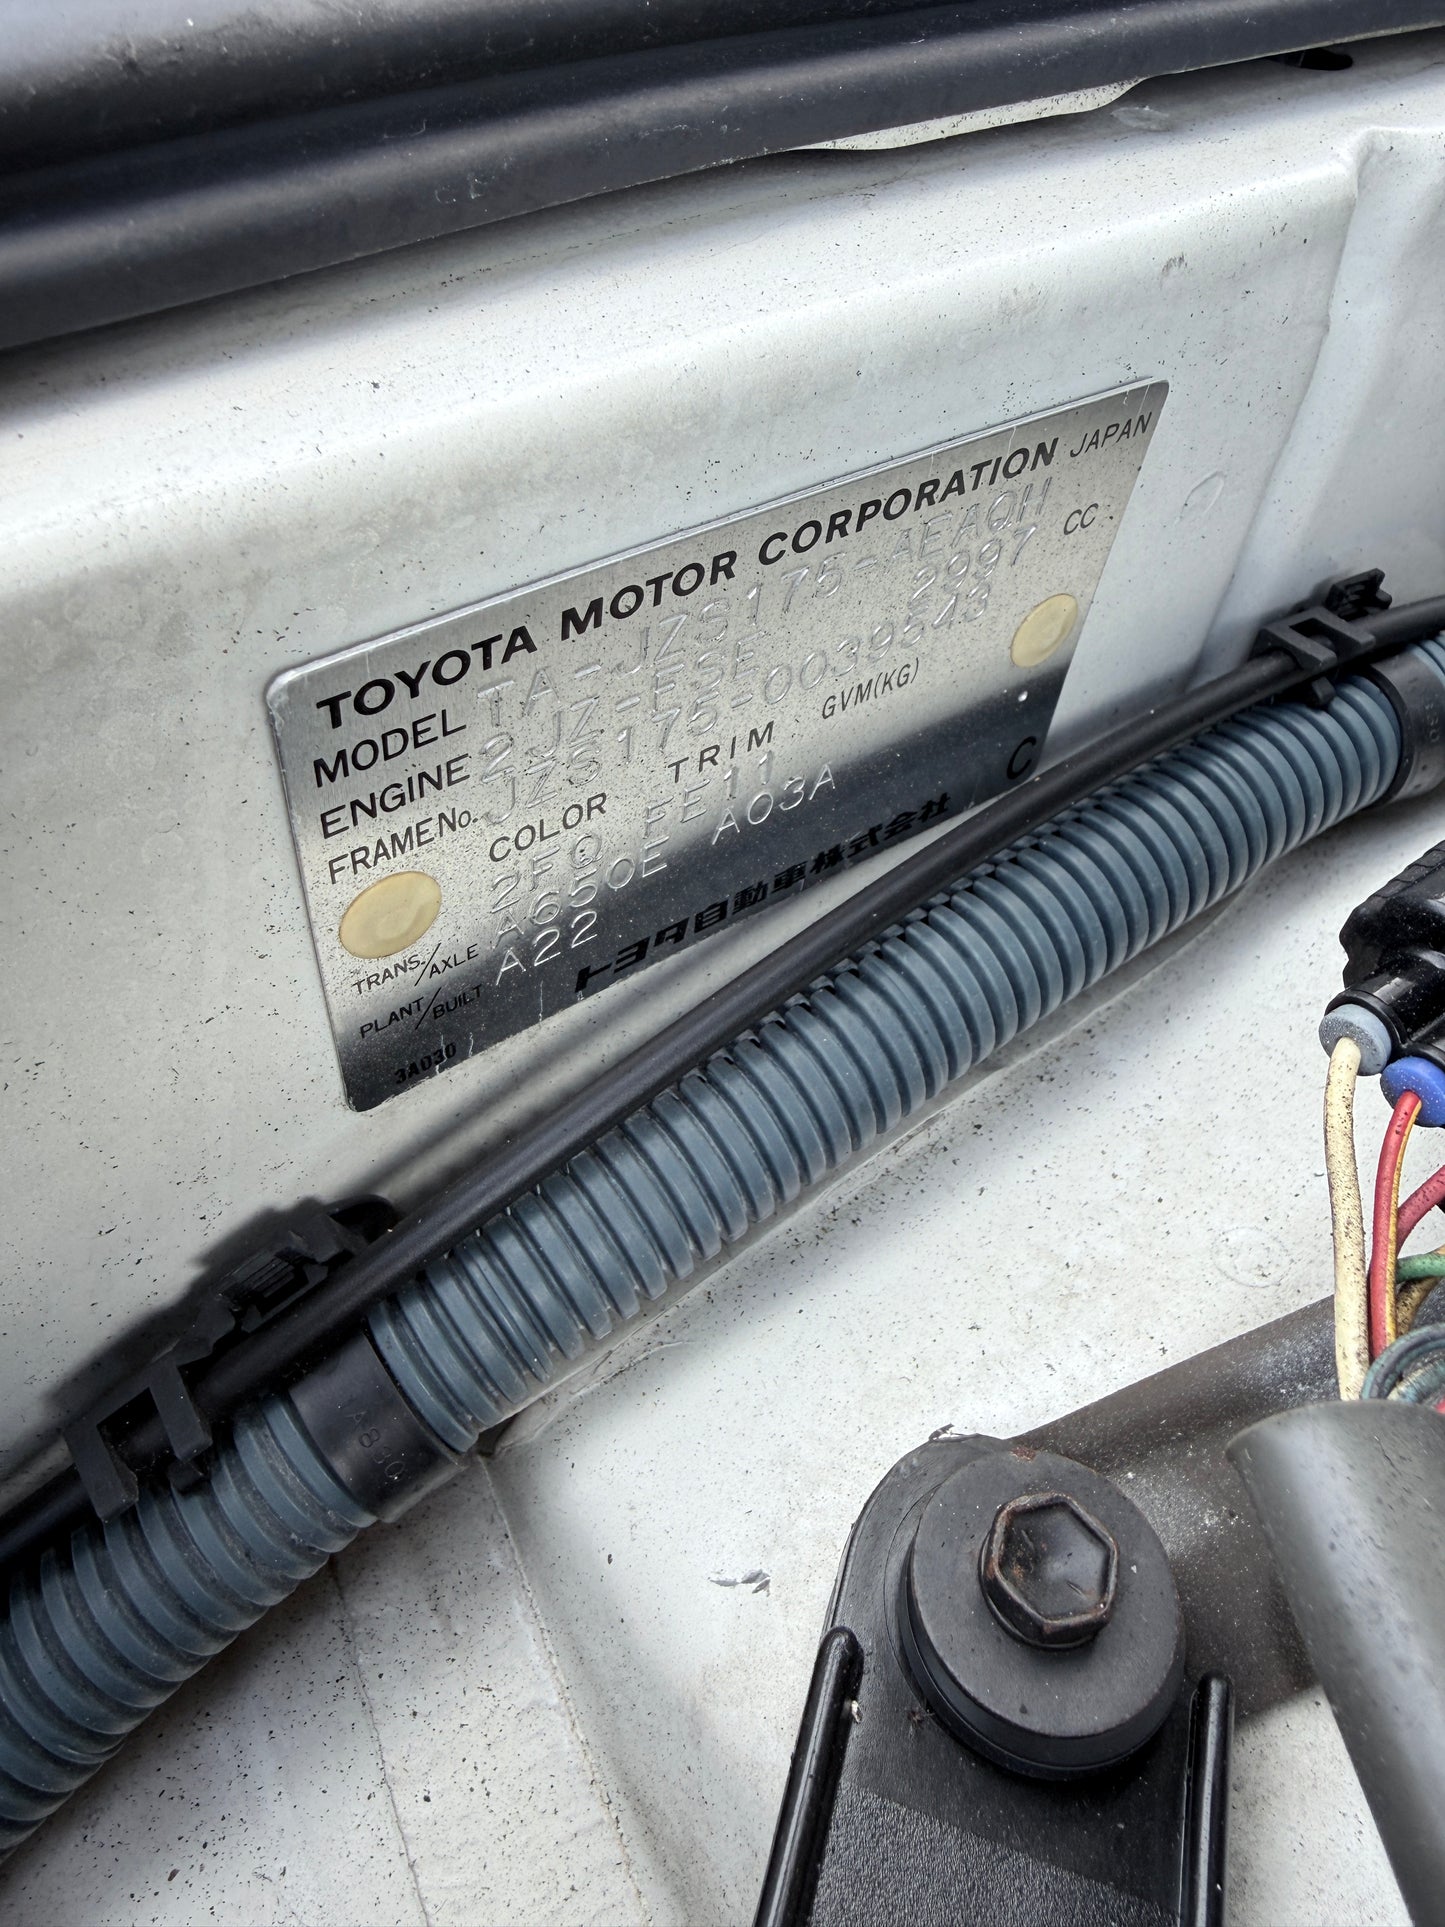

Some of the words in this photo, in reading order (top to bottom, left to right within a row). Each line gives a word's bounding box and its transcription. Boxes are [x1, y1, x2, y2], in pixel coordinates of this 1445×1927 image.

[315, 626, 538, 729] TOYOTA
[560, 550, 738, 641] MOTOR
[758, 437, 1059, 566] CORPORATION
[1070, 412, 1152, 458] JAPAN
[313, 709, 467, 788] MODEL
[320, 753, 472, 839] ENGINE
[481, 631, 767, 783] 2JZ-FSE
[908, 524, 1037, 608] 2997
[484, 582, 991, 826] JZS175-0039543
[489, 792, 608, 862] COLOR
[668, 721, 775, 783] TRIM
[822, 658, 920, 720] GVM(KG)
[1006, 736, 1037, 780] C
[575, 792, 952, 992] トヨタ自動車株式会社
[646, 750, 773, 839] FE11
[495, 910, 598, 986] A22
